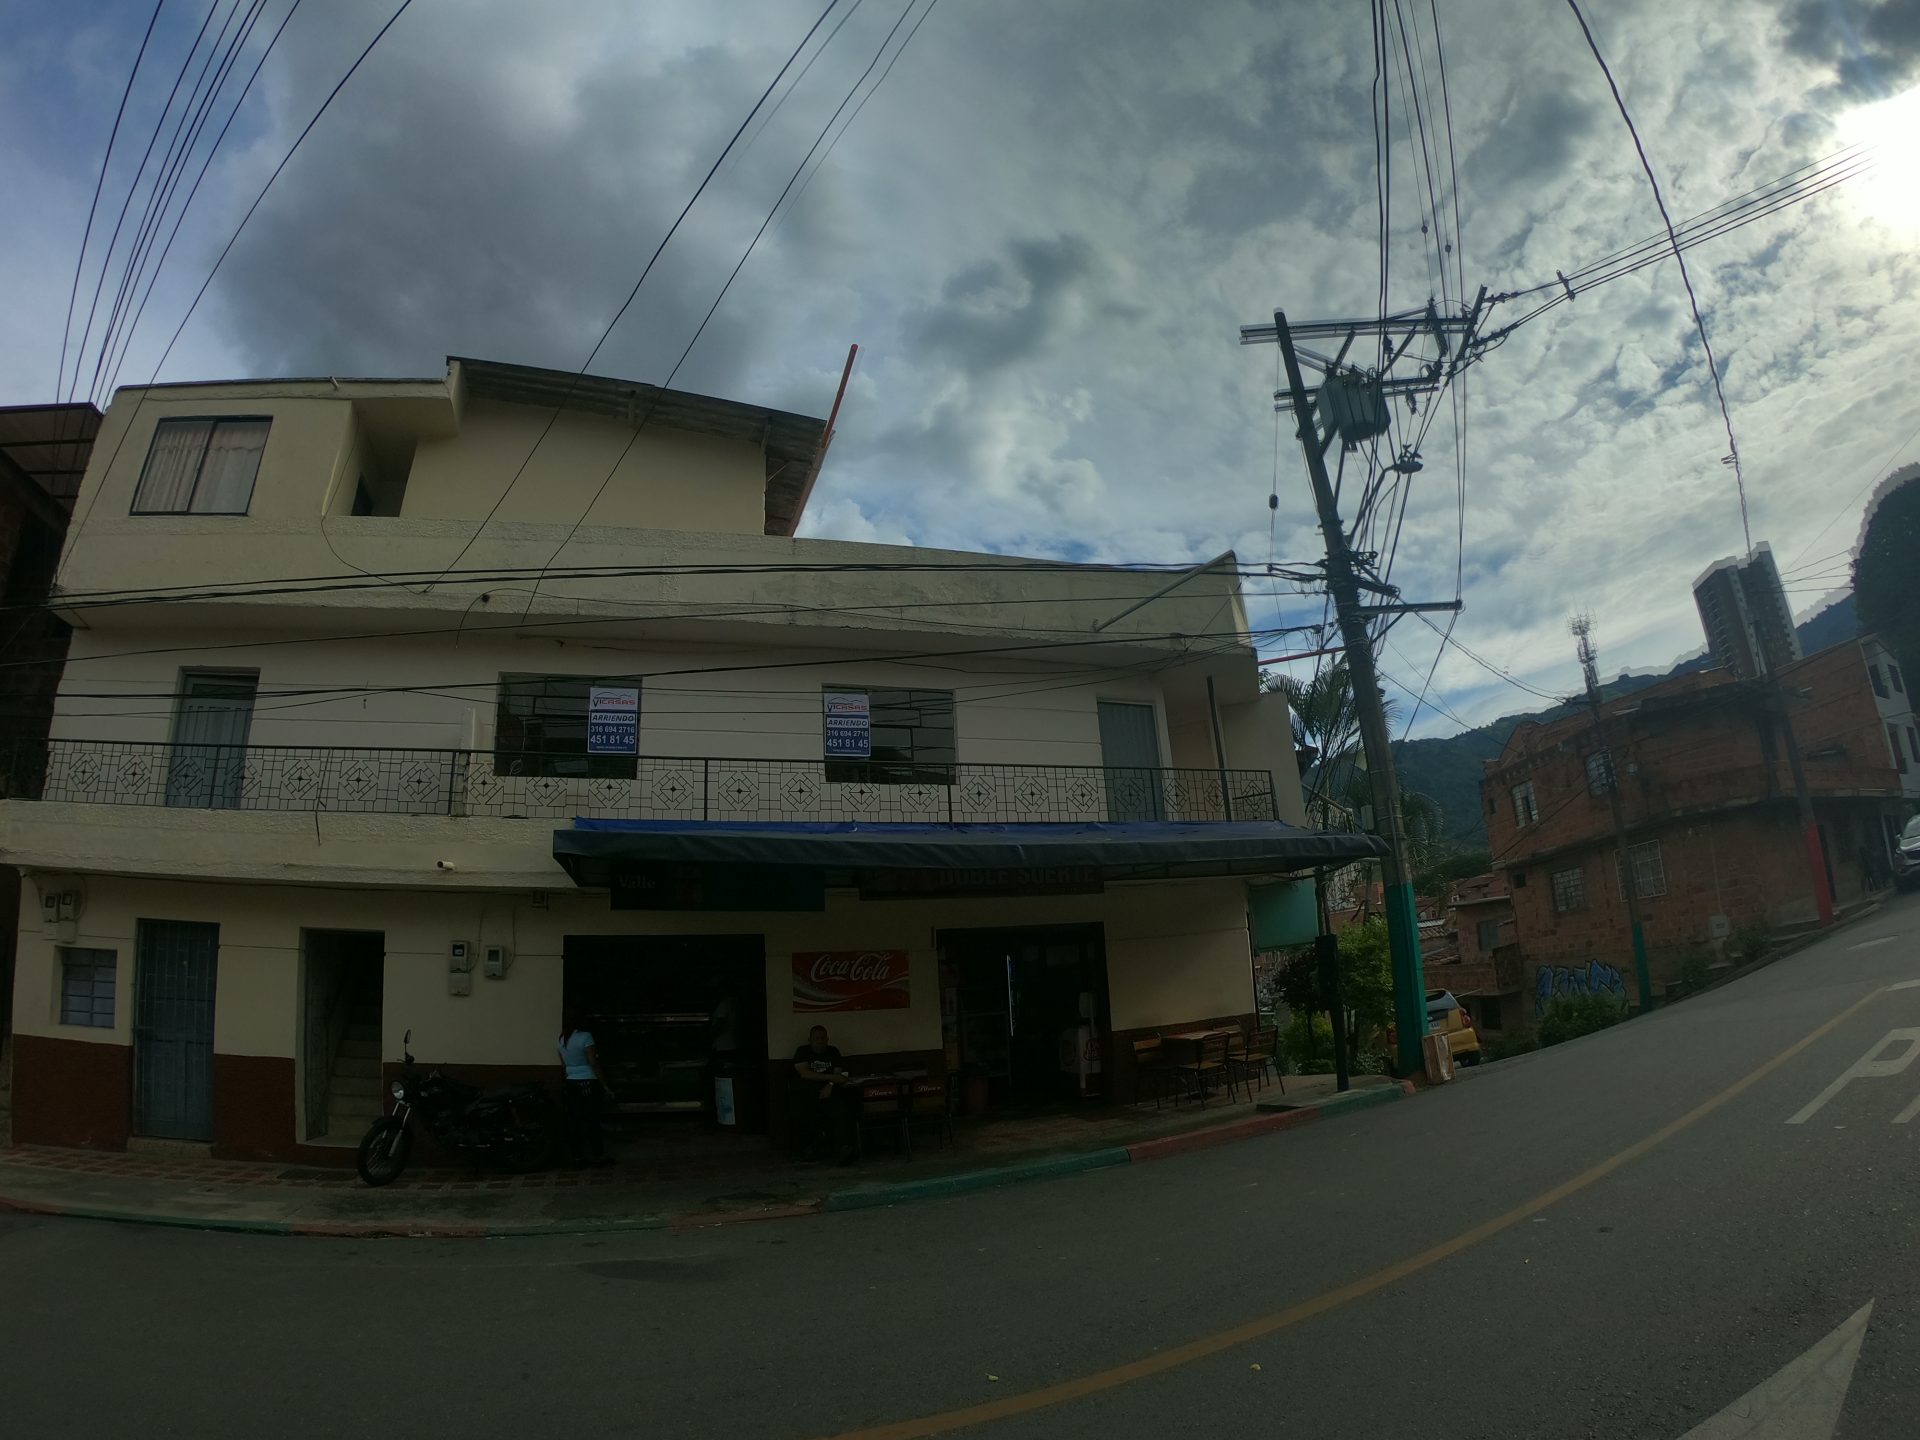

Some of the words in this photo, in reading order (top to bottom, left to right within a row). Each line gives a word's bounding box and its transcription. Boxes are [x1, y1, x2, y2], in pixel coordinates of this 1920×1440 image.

[593, 698, 635, 708] VICASAS
[593, 714, 634, 722] ARRIENDO
[591, 725, 604, 733] 316
[604, 725, 617, 733] 694
[618, 726, 635, 734] 2716
[590, 735, 607, 744] 451
[609, 735, 620, 744] 81
[622, 735, 635, 745] 45
[826, 738, 842, 747] 451
[845, 739, 855, 748] 81
[857, 739, 869, 748] 45
[810, 952, 894, 982] Coca-Cola
